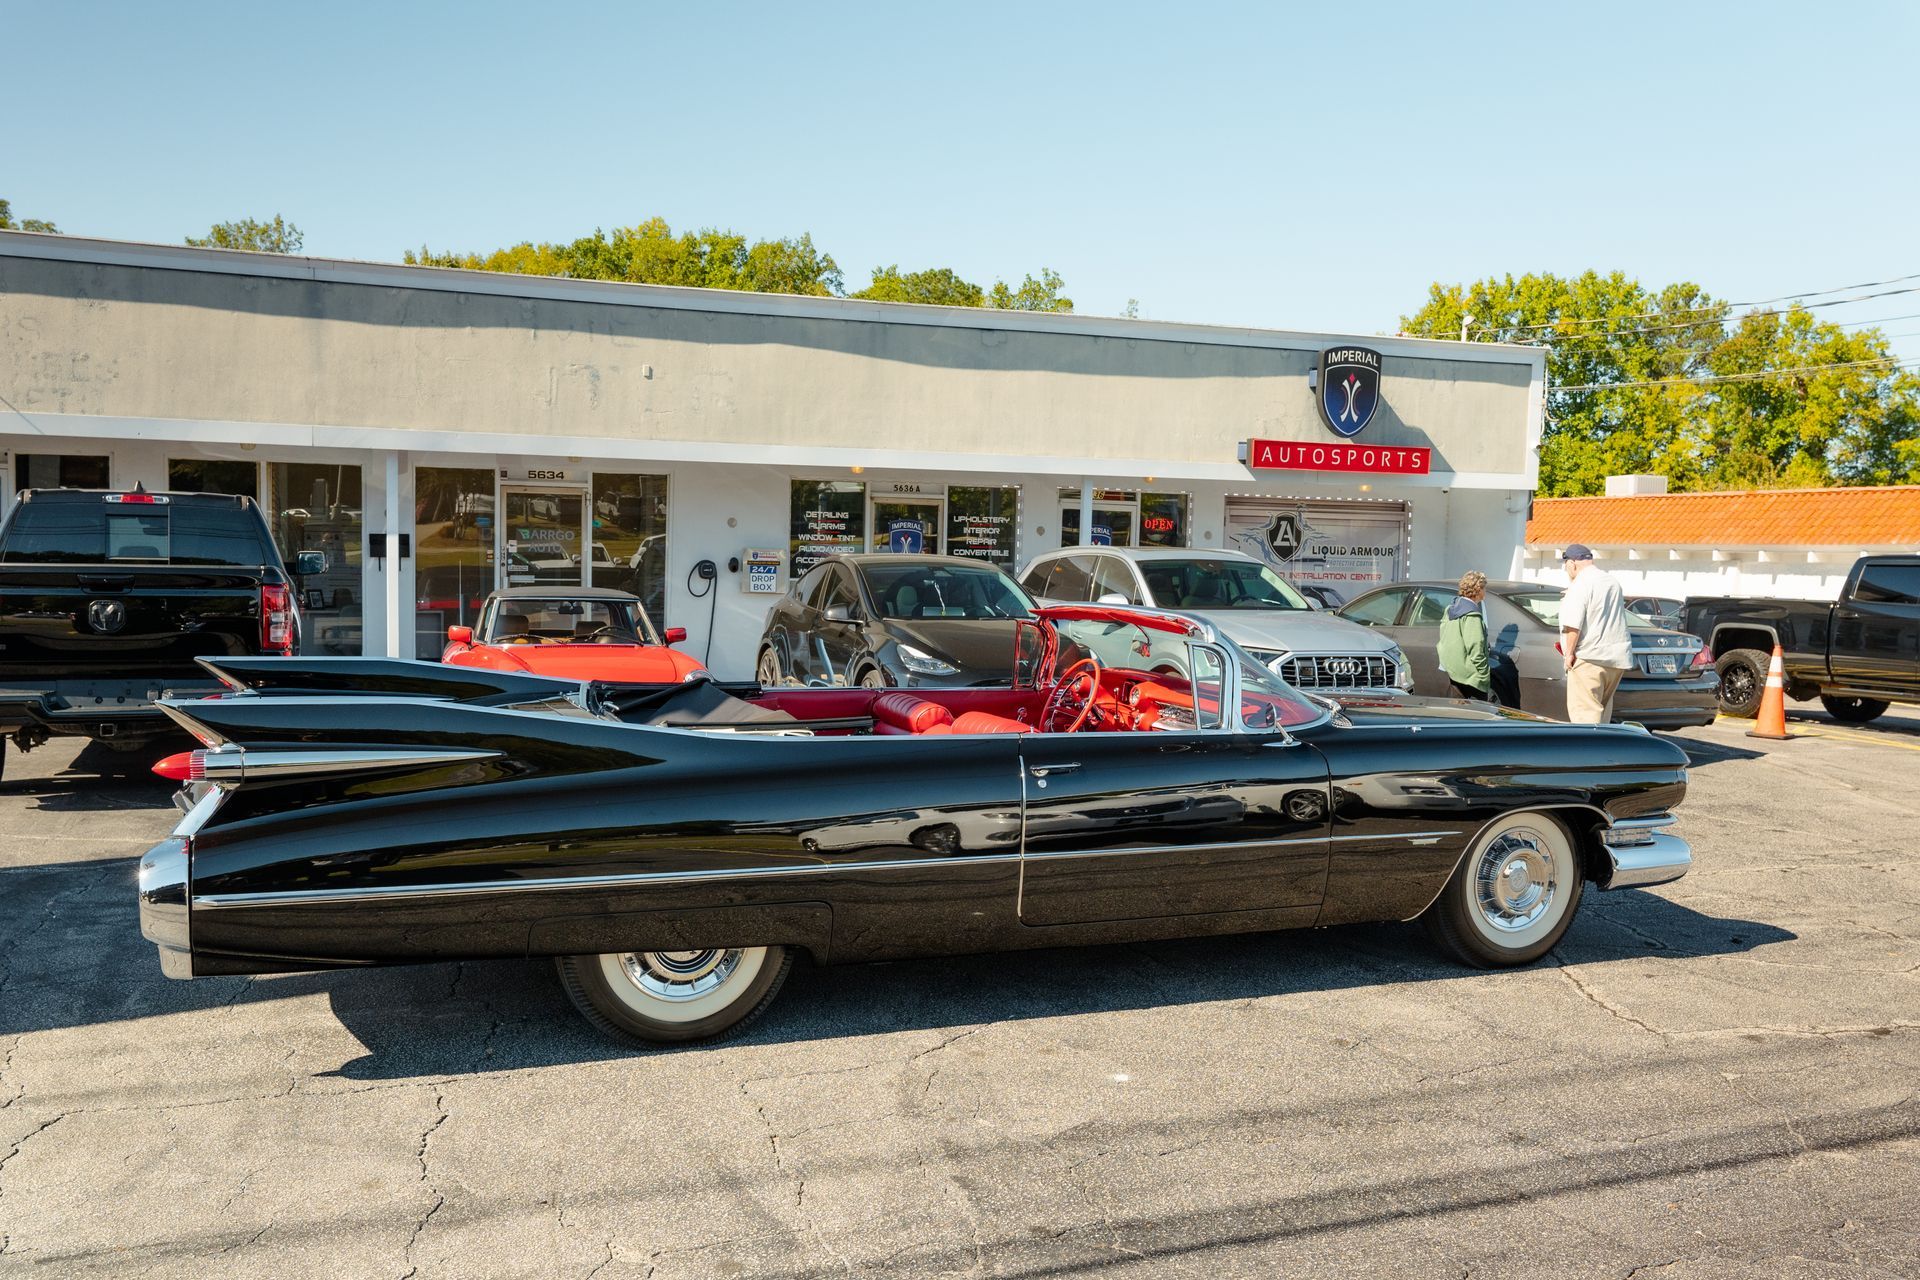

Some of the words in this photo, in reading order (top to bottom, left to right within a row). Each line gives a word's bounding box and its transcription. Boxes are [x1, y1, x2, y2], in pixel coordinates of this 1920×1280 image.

[1328, 350, 1379, 367] IMPERIAL
[1261, 446, 1422, 468] AUTOSPORTS
[528, 471, 564, 479] 5634
[915, 485, 921, 493] A
[805, 511, 849, 519] DETAILING
[953, 515, 1011, 524] UPHOLSTERY
[808, 522, 846, 530] ALARMS
[891, 521, 923, 531] IMPERIAL
[1144, 518, 1174, 530] OPEN
[963, 527, 1000, 535] INTERIOR
[1091, 528, 1111, 536] PERIAL
[798, 533, 833, 541] WINDOW
[966, 538, 998, 546] REPAIR
[798, 545, 855, 553] AUDIO/VIDEO
[953, 549, 1010, 557] CONVERTIBLE
[1312, 545, 1347, 559] LIQUID
[1350, 546, 1394, 557] ARMOUR
[1288, 571, 1347, 580] INSTALLATION
[1350, 573, 1382, 581] CENTER
